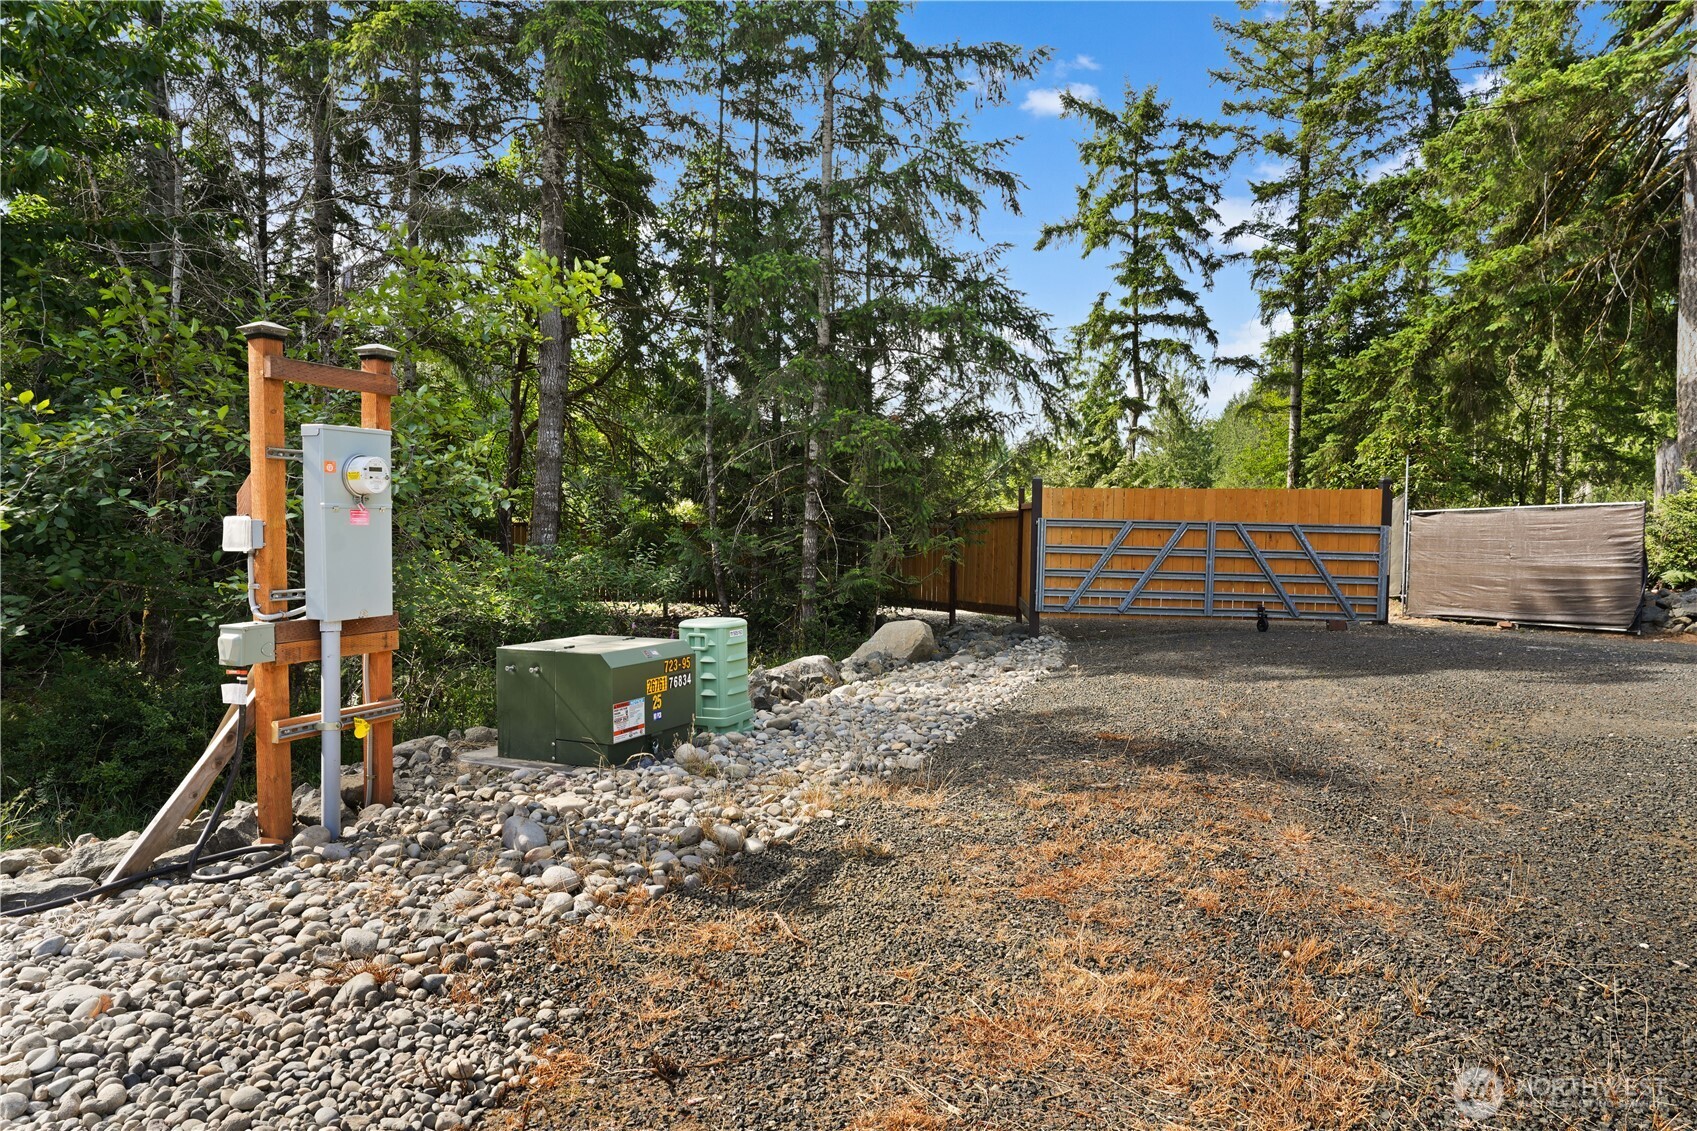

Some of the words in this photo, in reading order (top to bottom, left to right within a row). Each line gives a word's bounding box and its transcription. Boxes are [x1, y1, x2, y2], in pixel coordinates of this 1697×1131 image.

[664, 656, 691, 673] 723-95
[647, 677, 667, 694] 26761
[669, 673, 692, 689] 76834
[652, 694, 662, 710] 25
